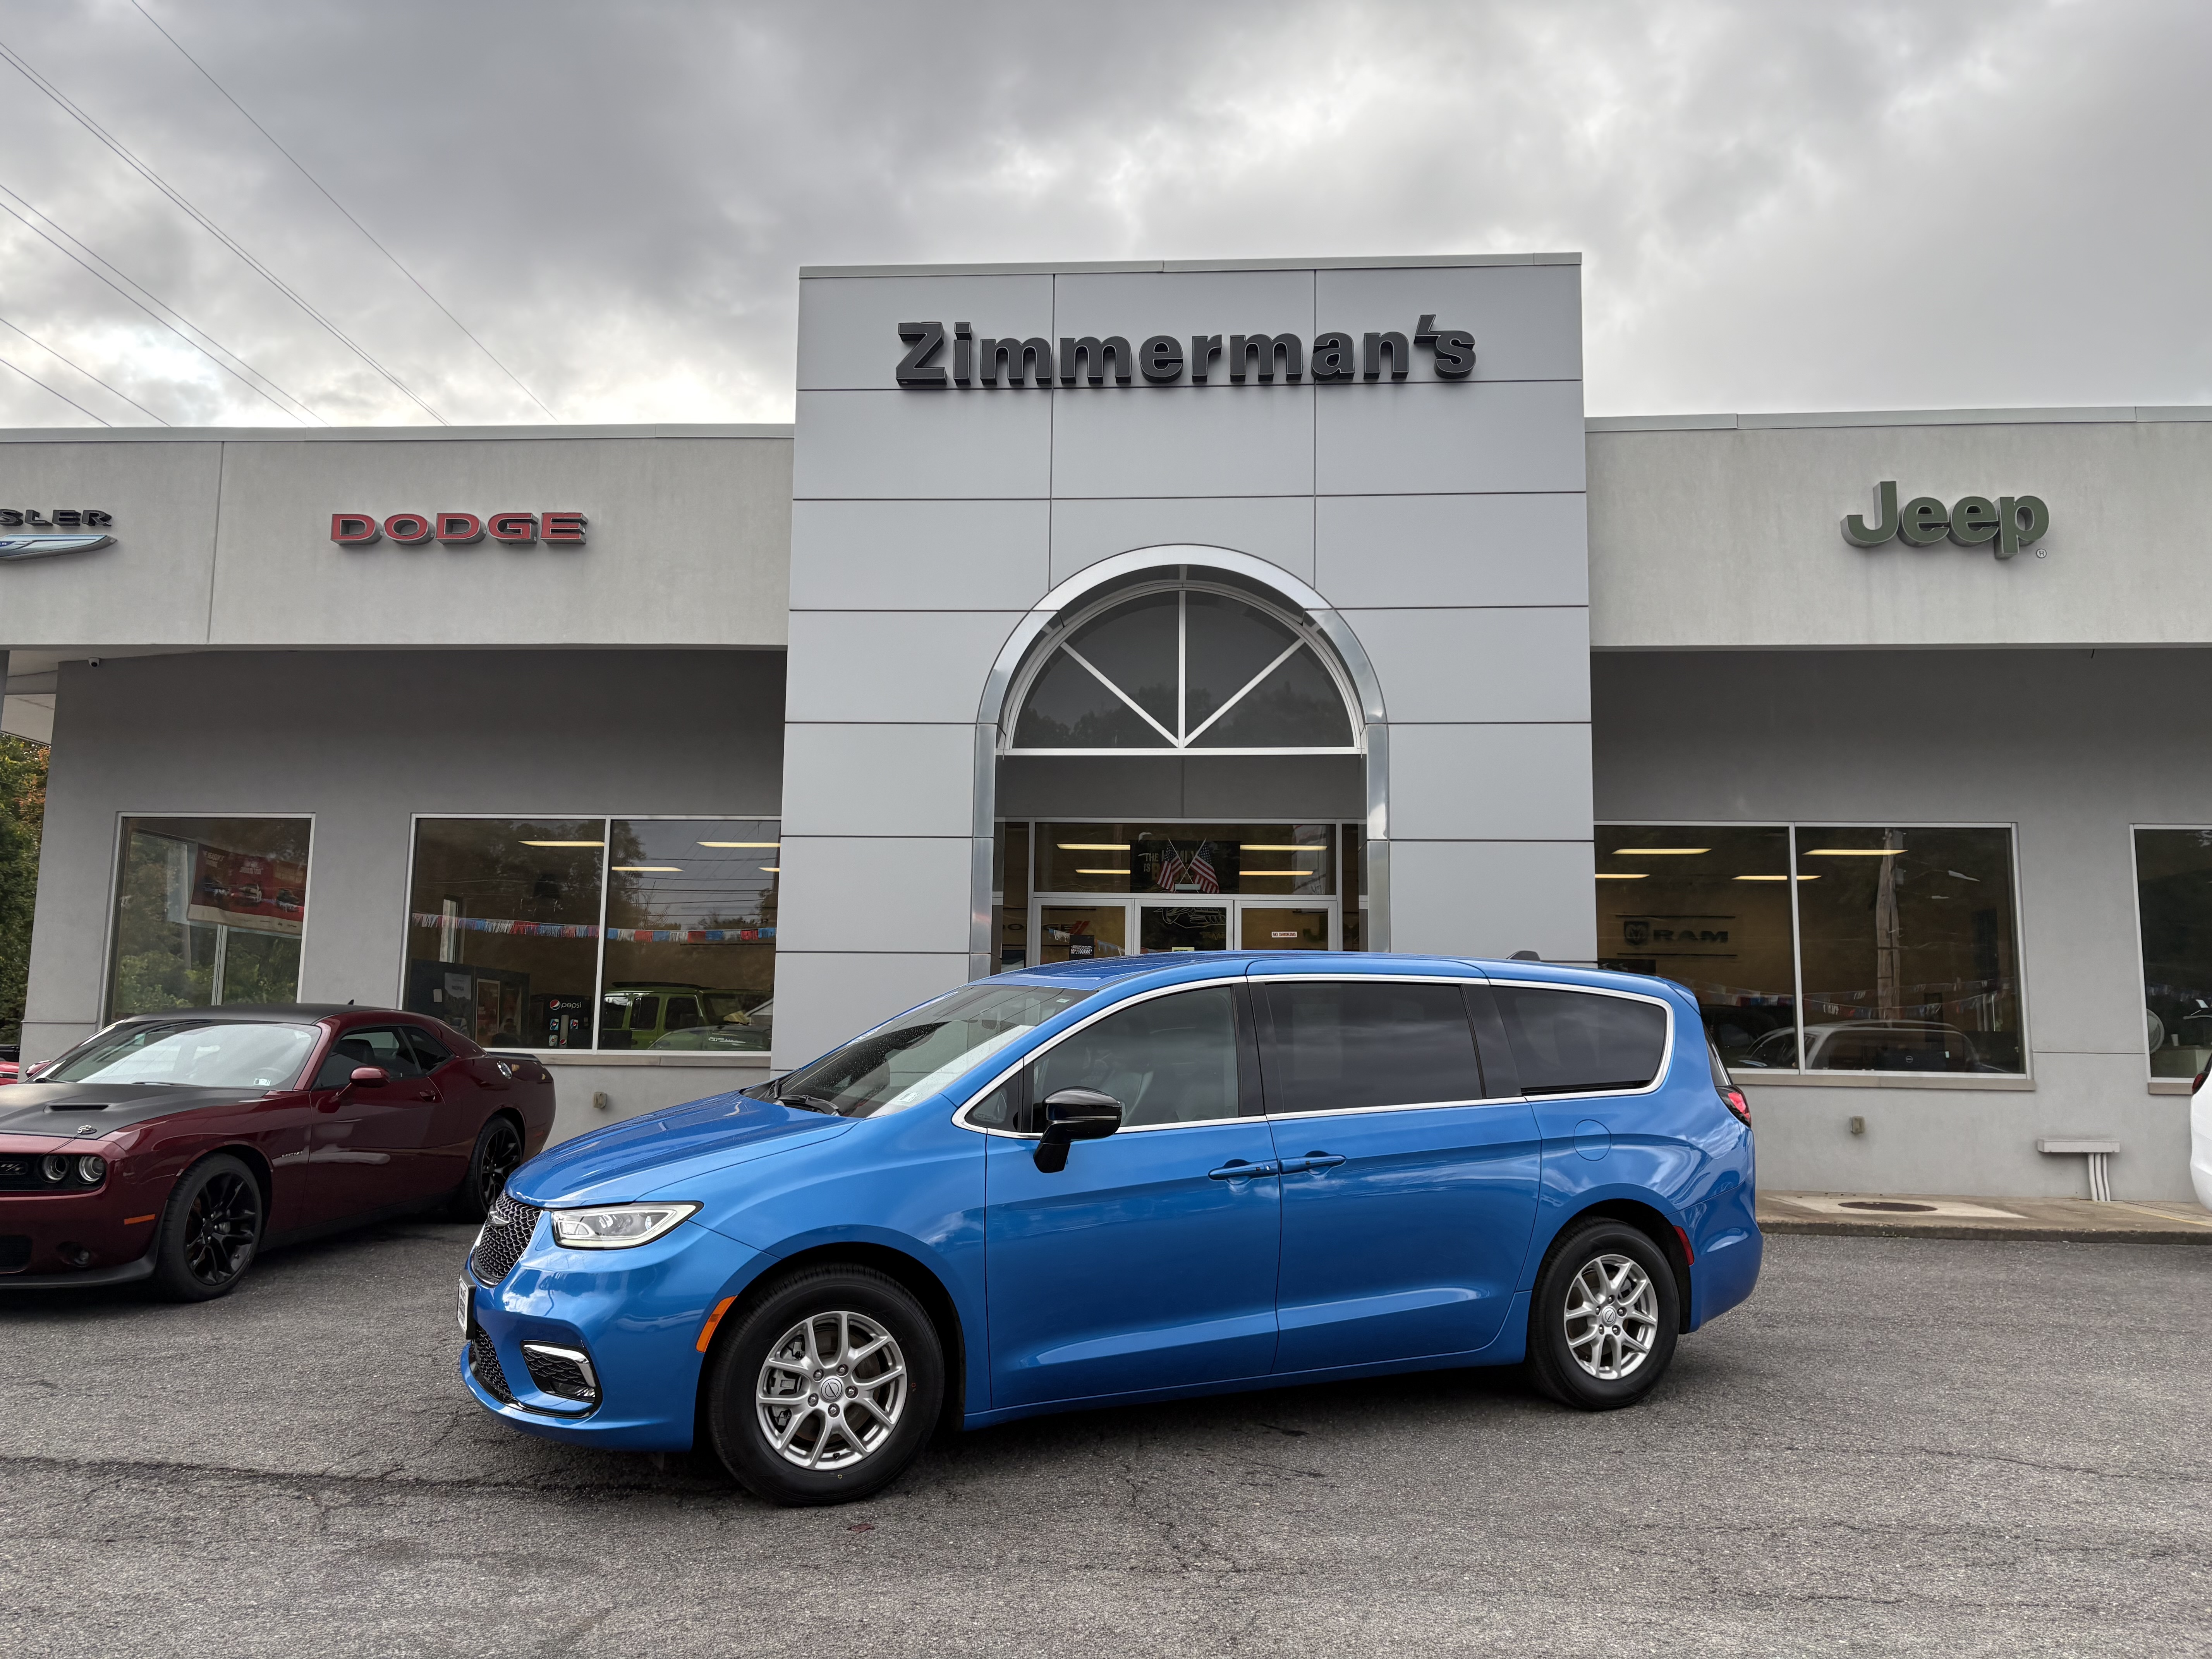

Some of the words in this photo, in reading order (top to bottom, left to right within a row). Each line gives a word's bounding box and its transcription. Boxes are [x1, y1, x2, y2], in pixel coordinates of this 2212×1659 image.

[896, 314, 1477, 385] Zimmerman's
[330, 512, 588, 545] DODGE
[1840, 481, 2049, 559] Jeep
[1146, 853, 1159, 862] THE
[1654, 929, 1728, 943] RAM
